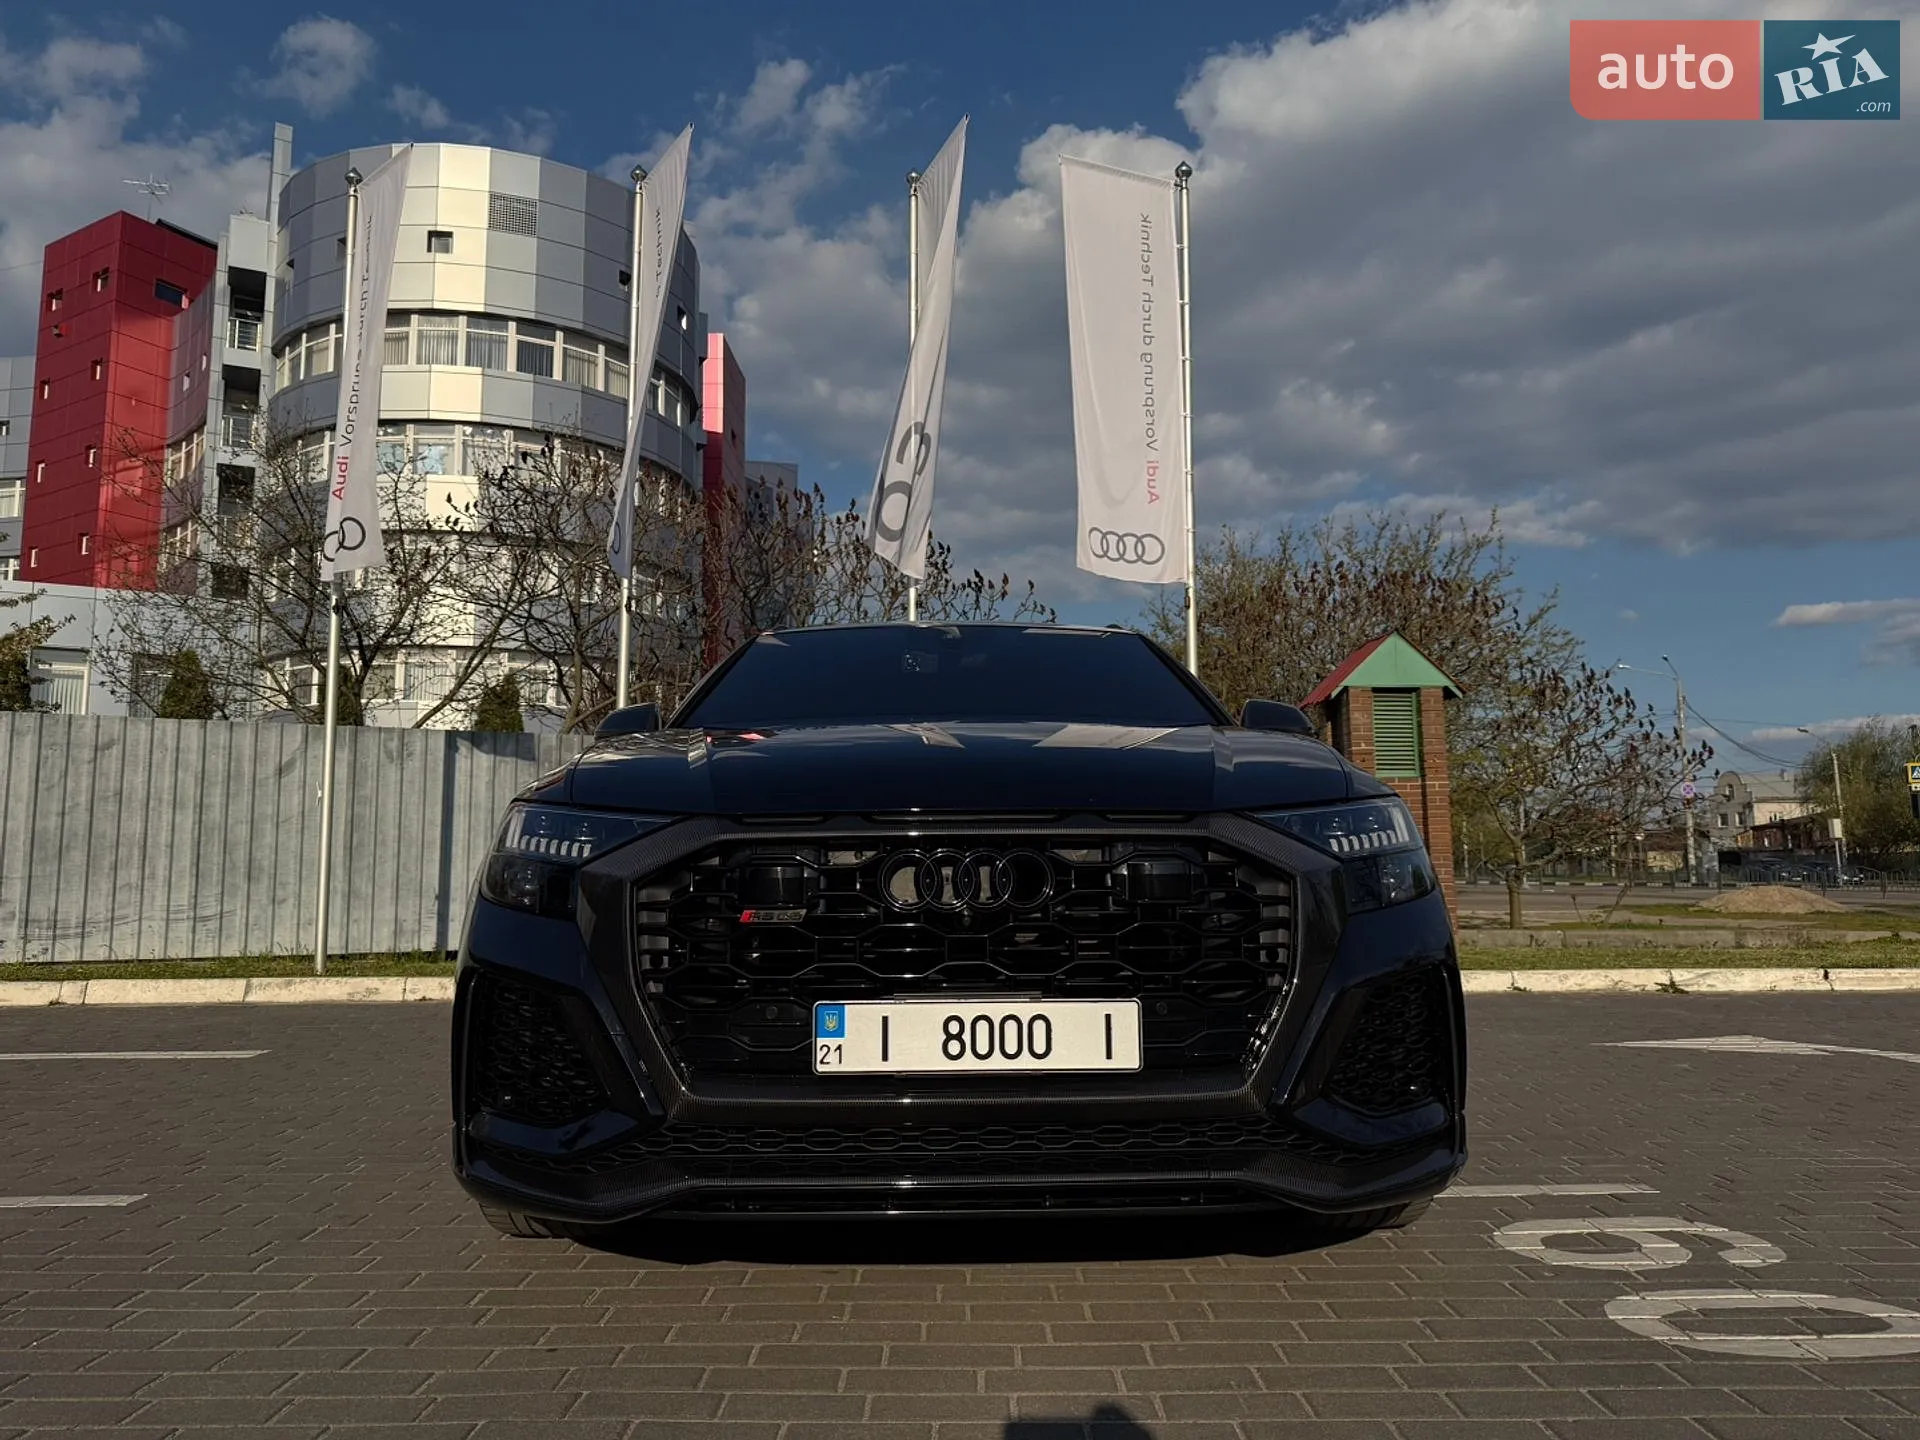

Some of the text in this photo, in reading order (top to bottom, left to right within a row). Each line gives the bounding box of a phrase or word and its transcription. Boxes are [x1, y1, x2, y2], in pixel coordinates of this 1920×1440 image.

[331, 455, 349, 501] Audi
[818, 1043, 843, 1066] 21
[941, 1014, 1052, 1061] 8000
